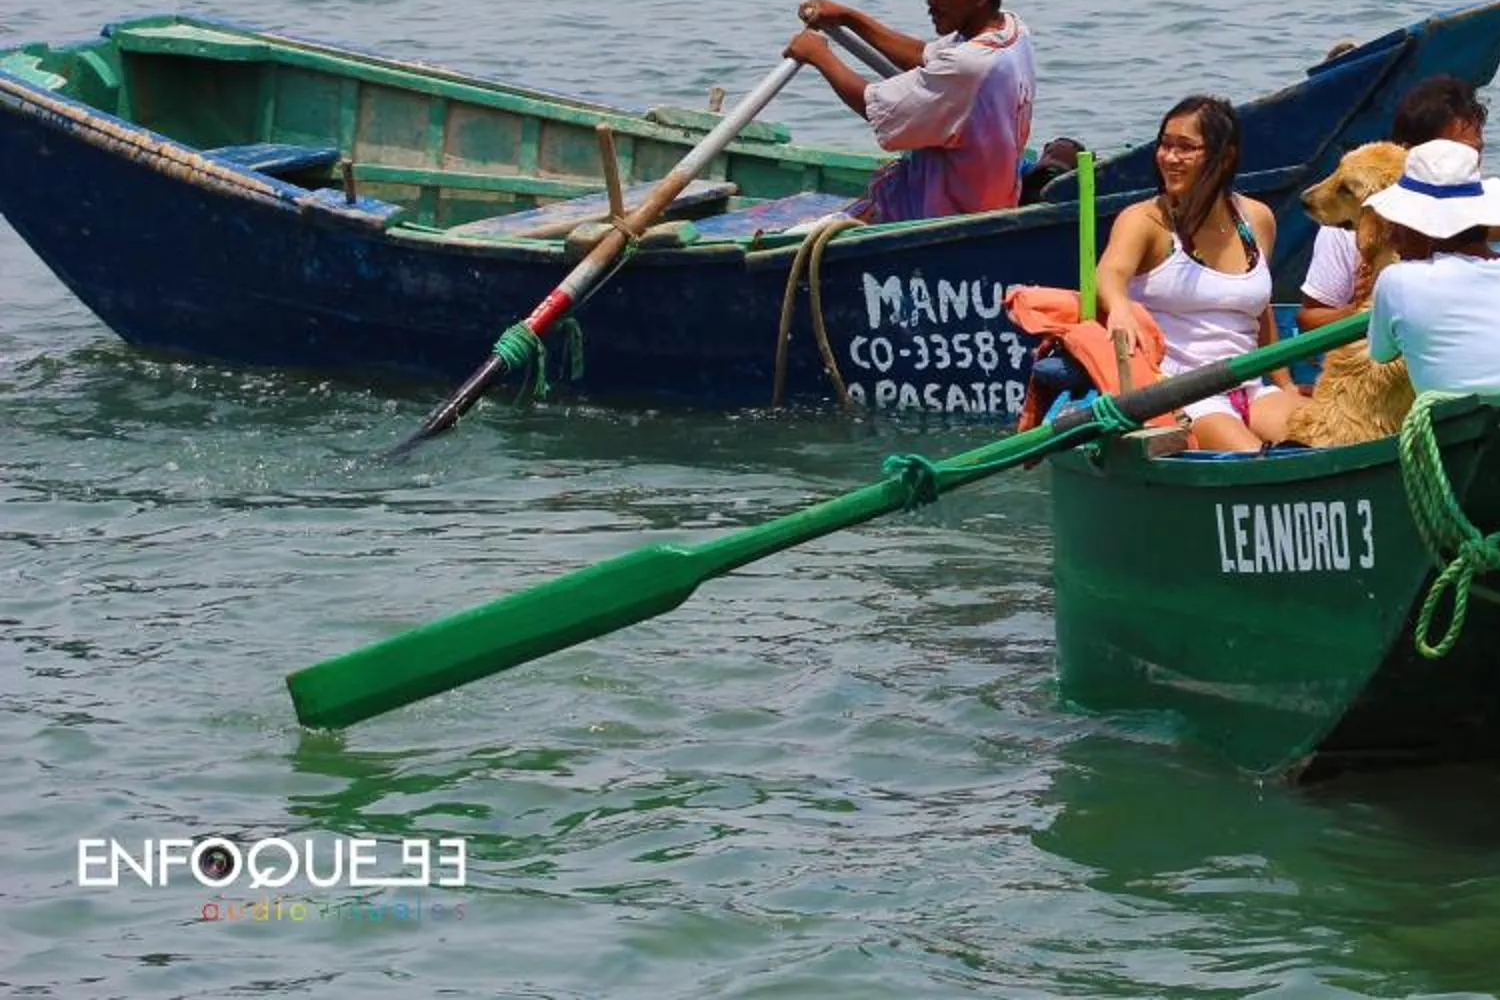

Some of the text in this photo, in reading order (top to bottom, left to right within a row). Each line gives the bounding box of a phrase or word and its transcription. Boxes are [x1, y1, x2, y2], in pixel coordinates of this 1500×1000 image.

[850, 331, 1026, 374] CO-33587
[1215, 499, 1374, 573] LEANDRO 3
